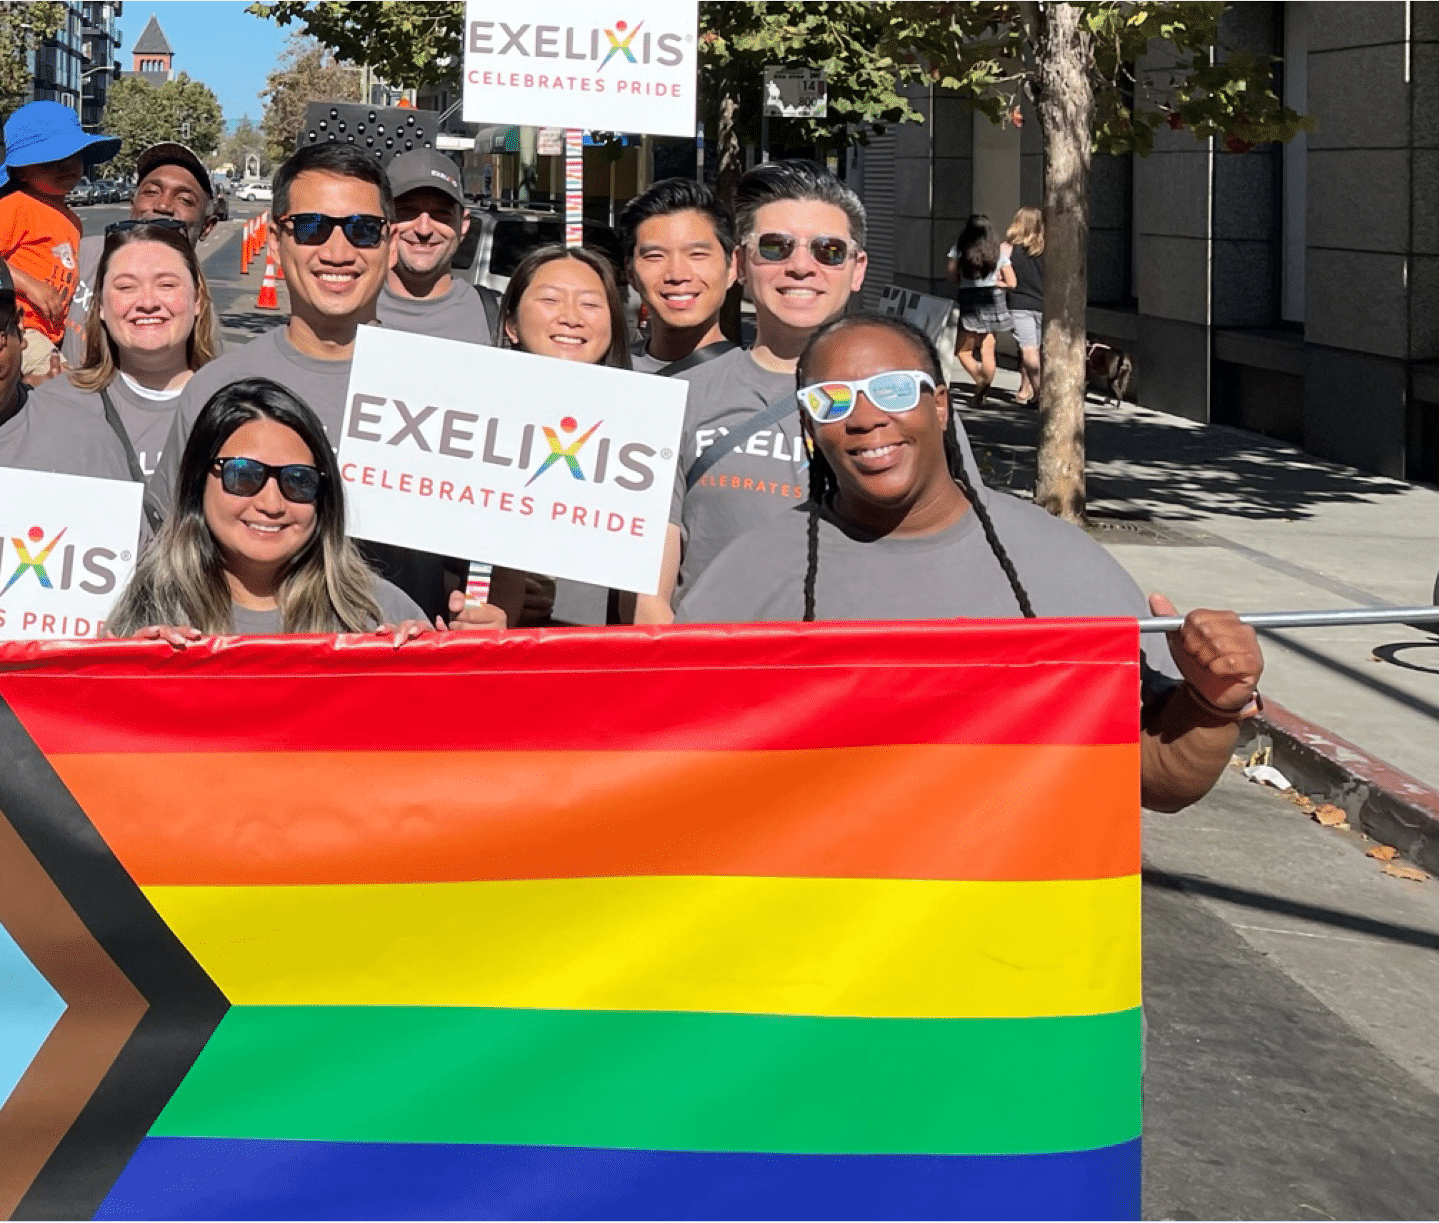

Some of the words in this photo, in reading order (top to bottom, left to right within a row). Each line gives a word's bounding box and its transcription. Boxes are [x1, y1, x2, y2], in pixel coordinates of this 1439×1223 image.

[468, 70, 606, 92] CELEBRATES
[616, 80, 682, 97] PRIDE
[341, 463, 534, 516] CELEBRATES
[551, 502, 646, 538] PRIDE
